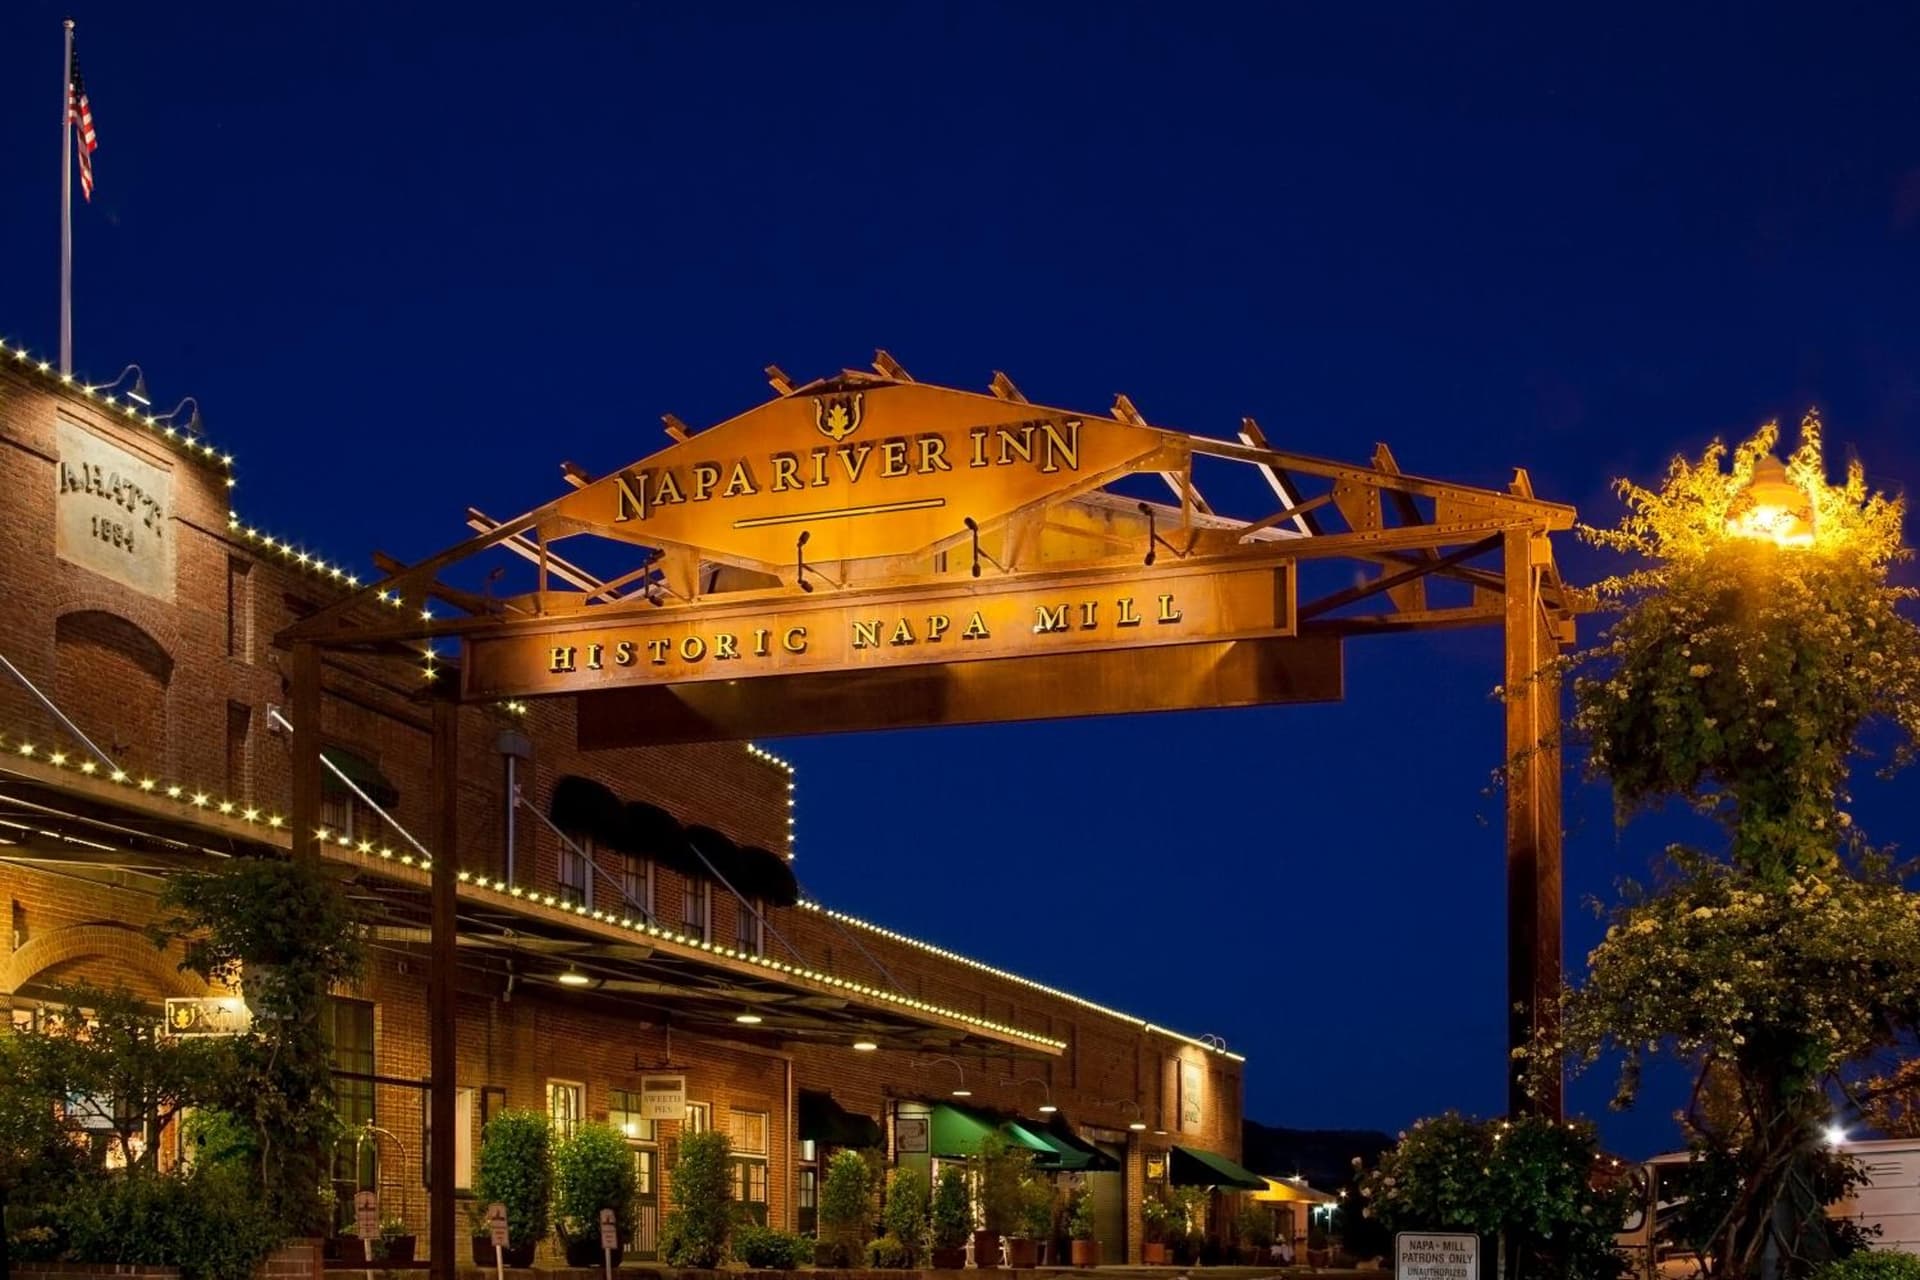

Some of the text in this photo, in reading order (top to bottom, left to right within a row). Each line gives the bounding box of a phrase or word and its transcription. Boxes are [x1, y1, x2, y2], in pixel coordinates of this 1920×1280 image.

[613, 421, 1081, 522] NAPA RIVER INN
[92, 514, 135, 553] 1884
[549, 594, 1181, 672] HISTORIC NAPA MILL
[1402, 1252, 1473, 1265] PATRONS ONLY
[1409, 1240, 1466, 1252] NAPA MILL
[1407, 1266, 1468, 1278] UNAUTHORIZED
